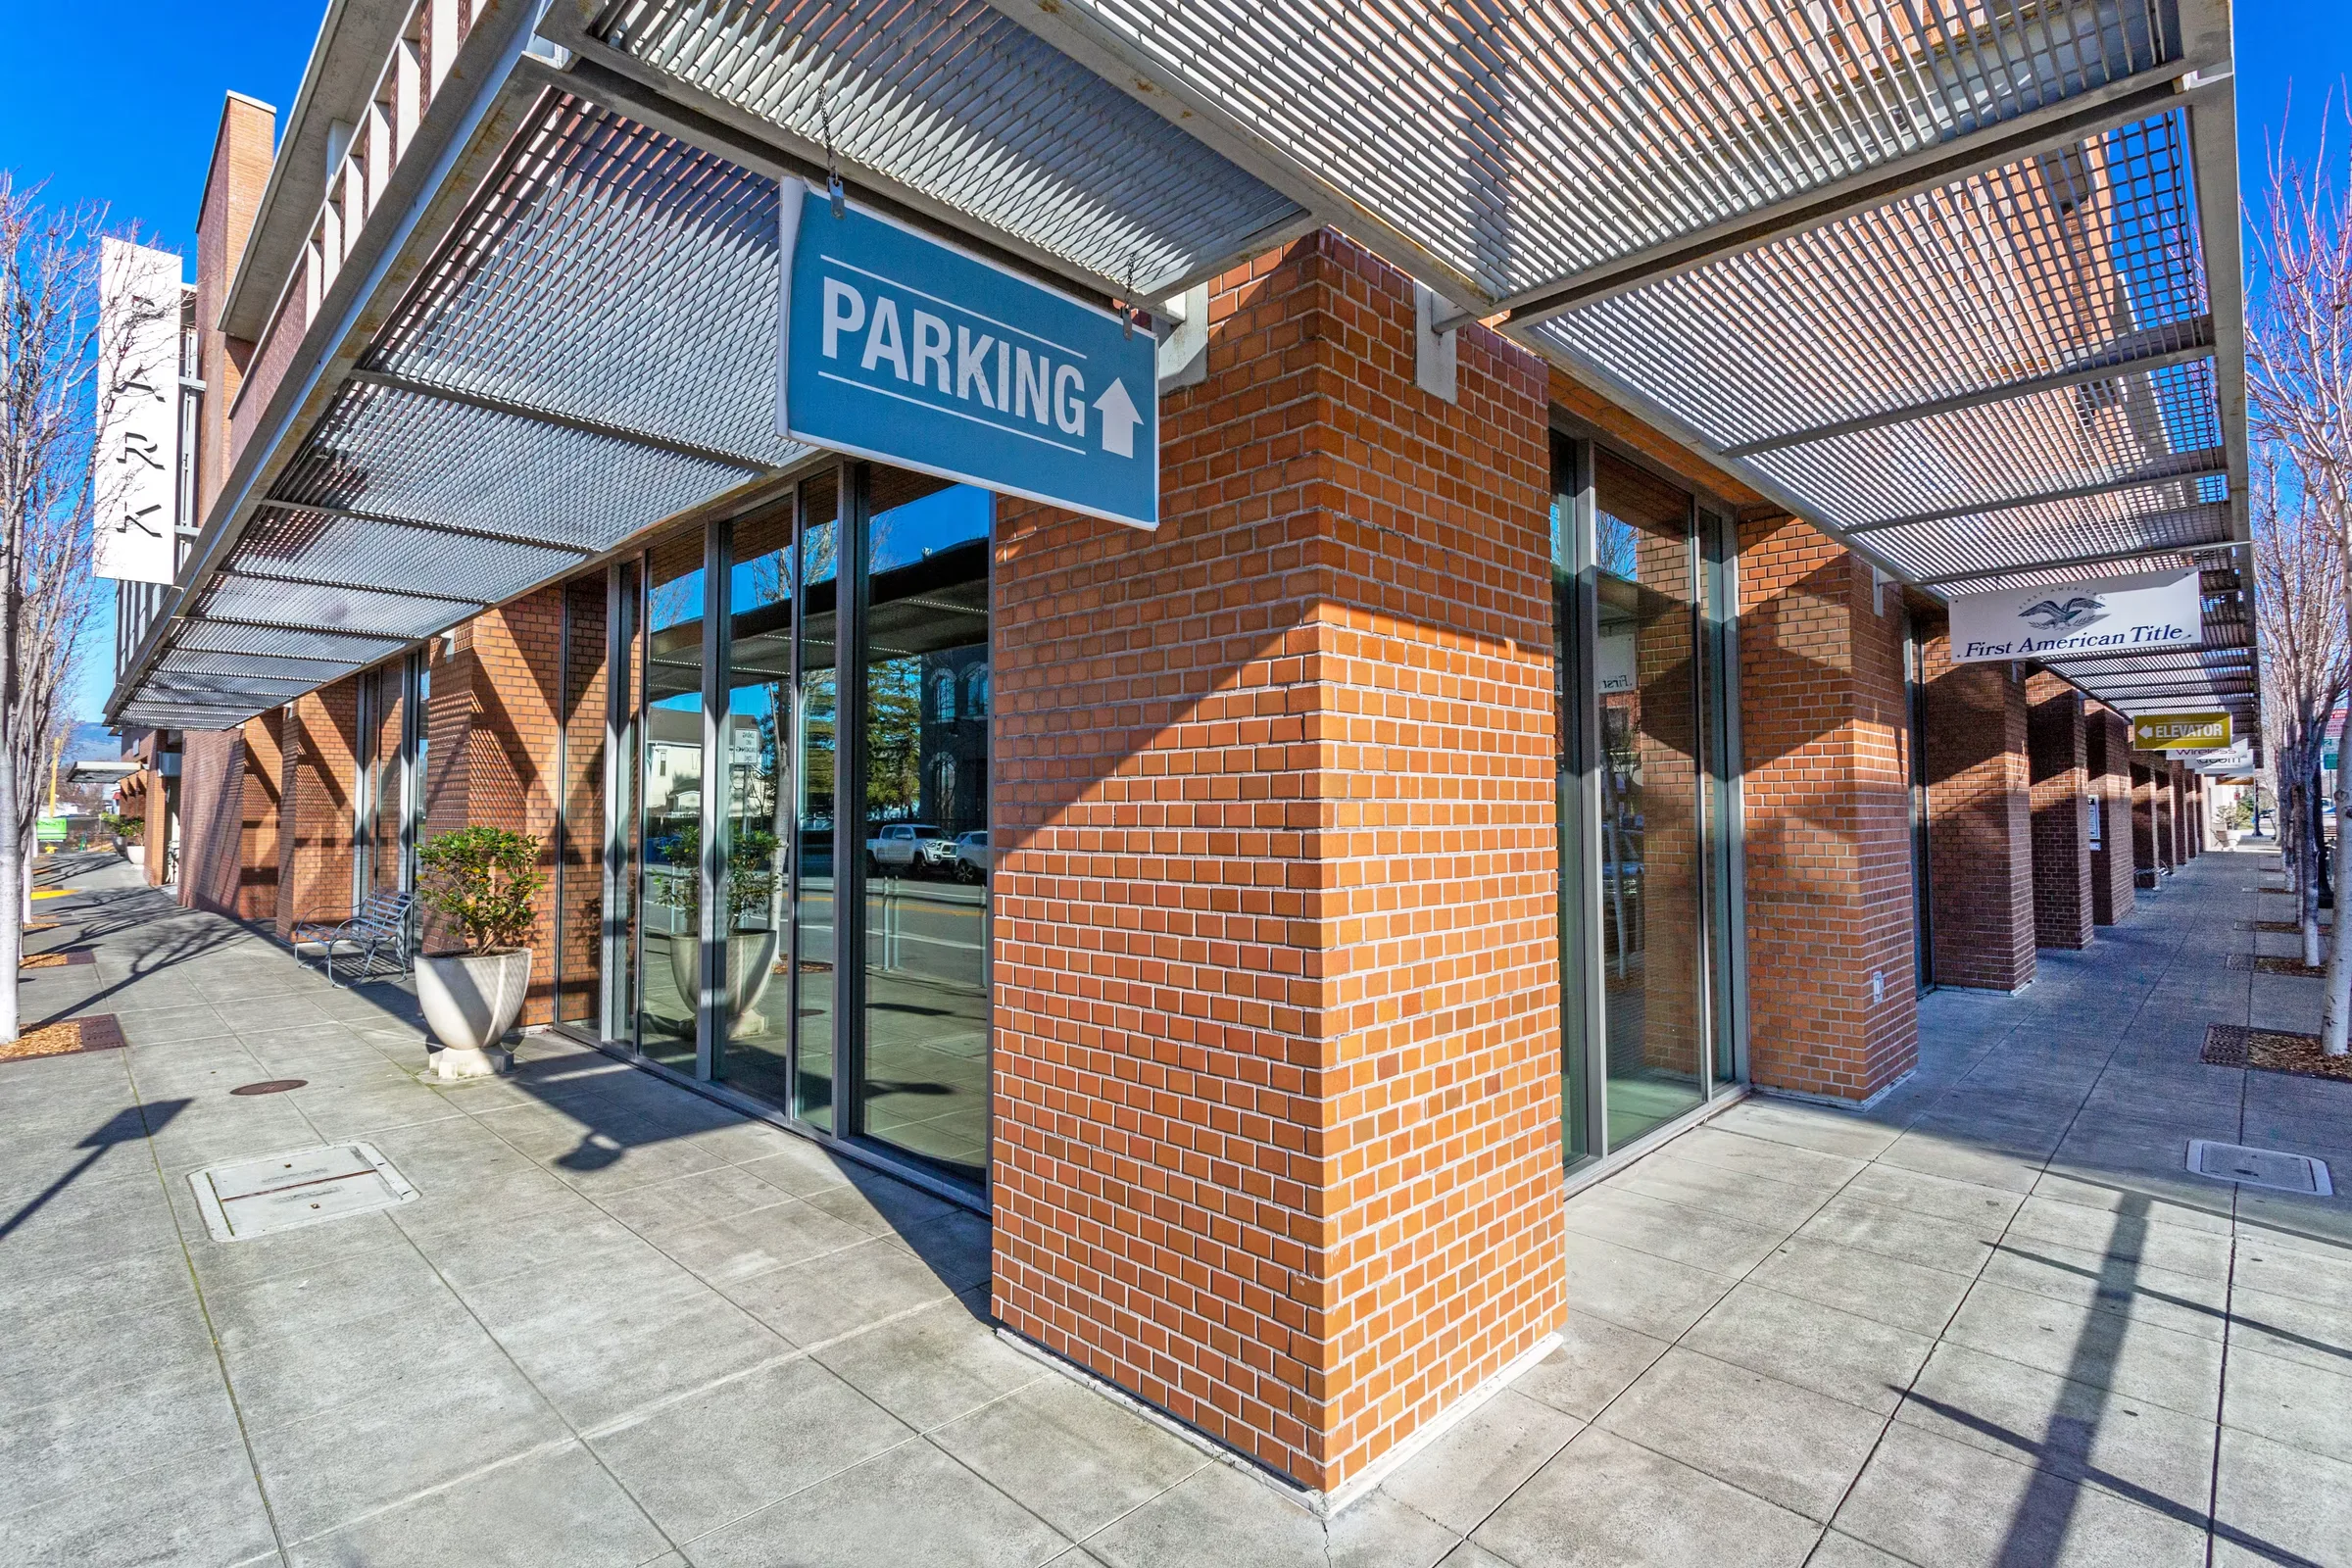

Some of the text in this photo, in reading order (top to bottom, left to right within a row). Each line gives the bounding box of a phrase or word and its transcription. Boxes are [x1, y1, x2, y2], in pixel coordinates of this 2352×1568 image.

[822, 276, 1086, 438] PARKING
[2019, 587, 2104, 610] FIRST AMERICAN
[1965, 623, 2183, 658] First American Title
[2156, 724, 2223, 738] ELEVATOR
